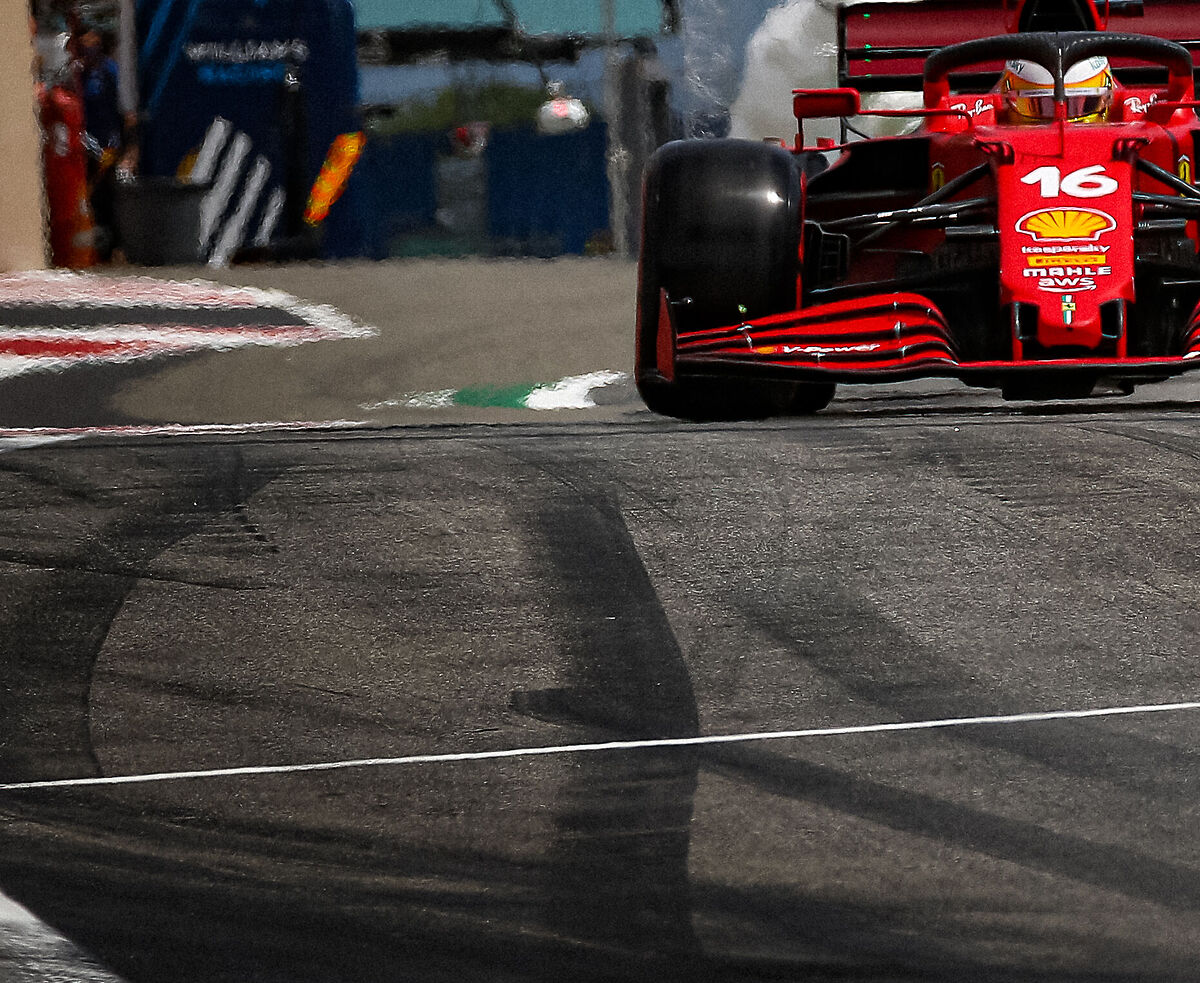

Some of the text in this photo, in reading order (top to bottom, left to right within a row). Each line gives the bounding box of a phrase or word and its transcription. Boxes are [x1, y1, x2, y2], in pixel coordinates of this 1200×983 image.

[1020, 164, 1119, 198] 16
[1023, 266, 1112, 276] MAHLE
[1038, 277, 1096, 288] aws
